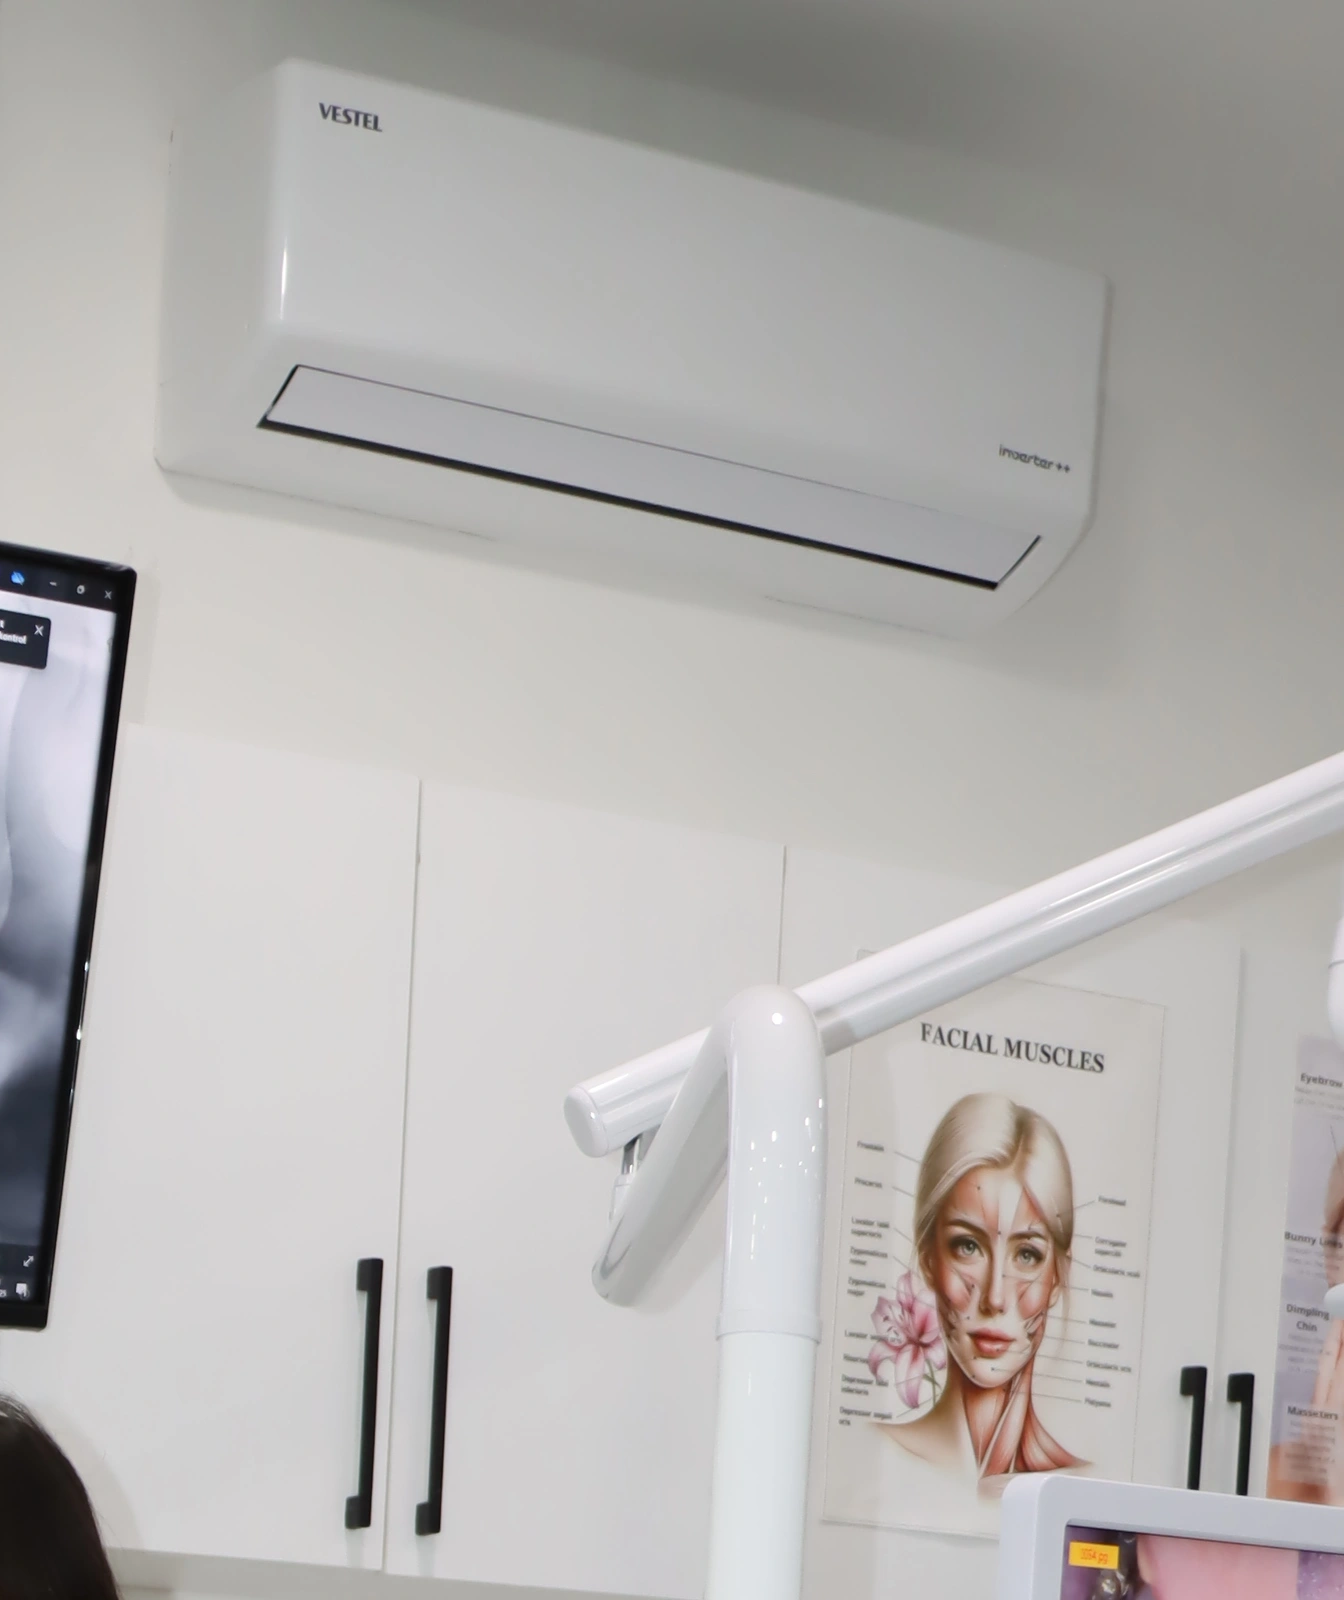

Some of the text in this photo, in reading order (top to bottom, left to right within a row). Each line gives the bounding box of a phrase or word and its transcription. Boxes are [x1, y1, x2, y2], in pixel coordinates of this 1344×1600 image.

[318, 101, 383, 133] VESTEL
[920, 1021, 1105, 1074] FACIAL MUSCLES
[1284, 1231, 1316, 1246] Bunny
[1286, 1303, 1330, 1321] Dimpling
[1296, 1321, 1318, 1332] Chin
